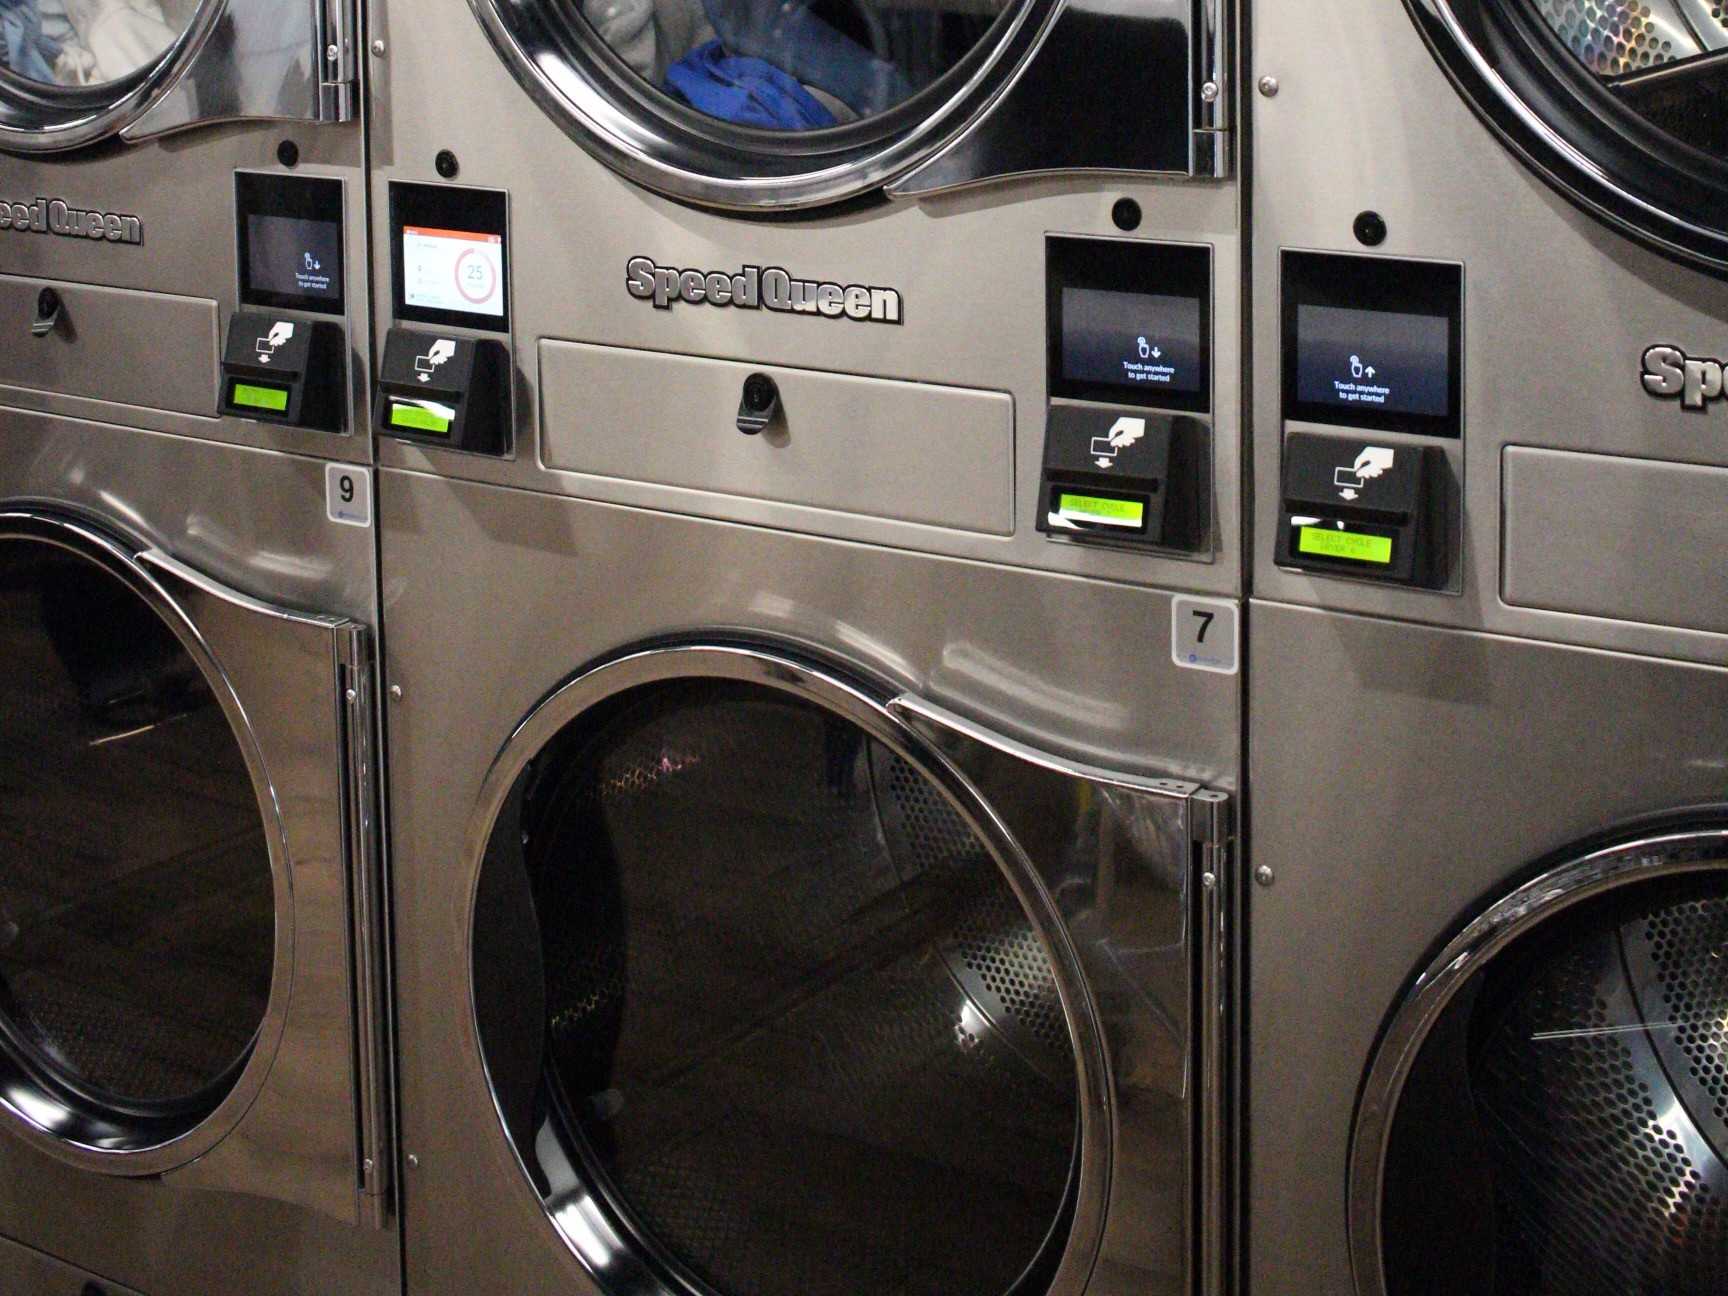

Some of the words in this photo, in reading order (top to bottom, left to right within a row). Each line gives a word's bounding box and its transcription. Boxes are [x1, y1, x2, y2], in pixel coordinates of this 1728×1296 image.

[467, 265, 483, 280] 25
[1123, 361, 1143, 370] Touch
[1144, 365, 1175, 374] anywhere
[1136, 372, 1147, 380] get
[1147, 373, 1170, 382] started
[1640, 344, 1728, 410] Sp
[1334, 380, 1355, 391] Touch
[1356, 385, 1390, 395] anywhere
[1339, 391, 1347, 399] to
[1348, 392, 1360, 401] get
[1360, 394, 1385, 403] started
[339, 475, 354, 503] 9
[1070, 498, 1098, 509] SELECT
[1311, 531, 1341, 544] SELECT
[1345, 536, 1372, 548] CYCLE
[1192, 609, 1214, 643] 7
